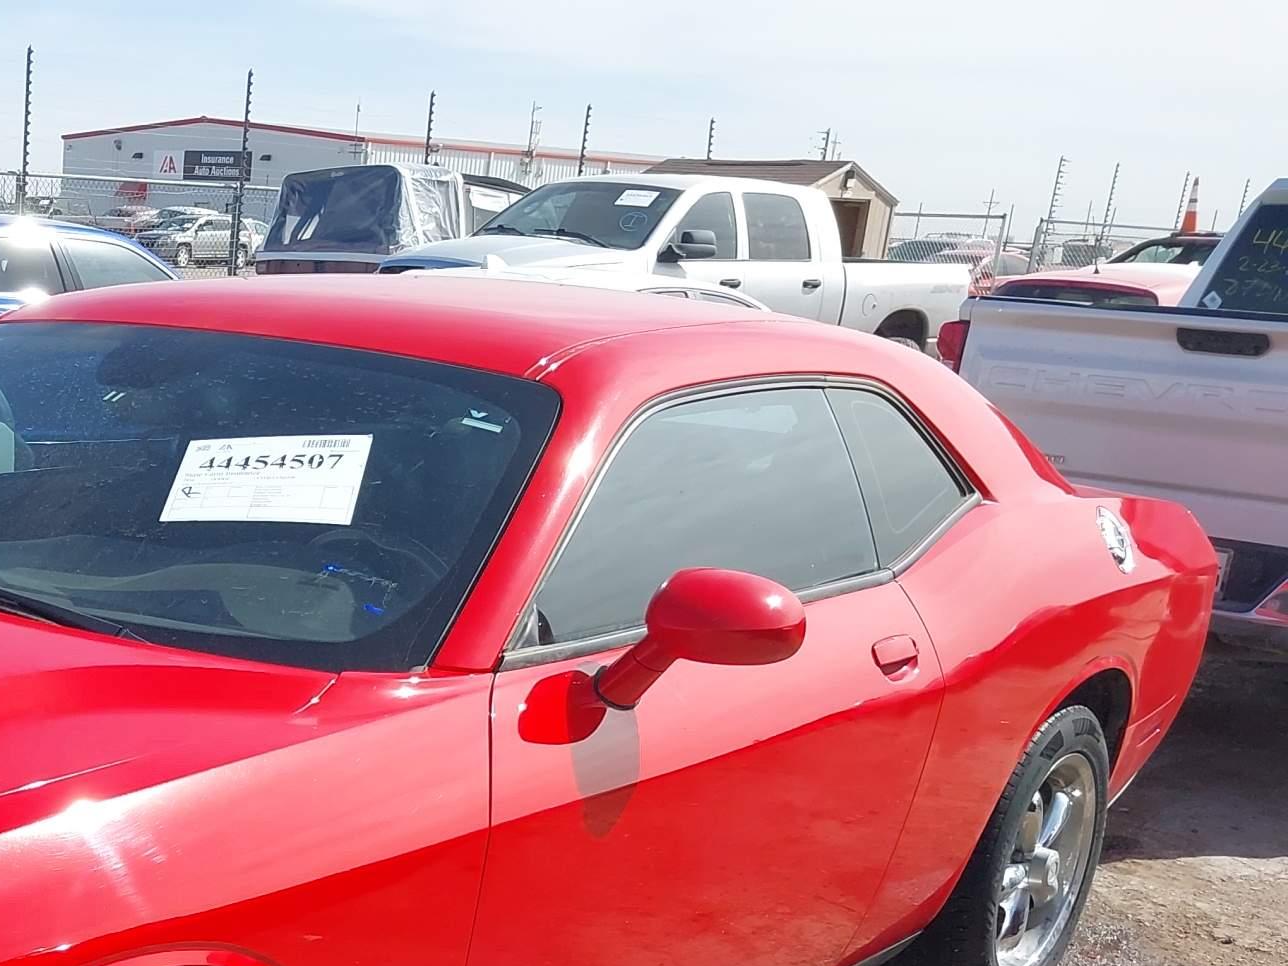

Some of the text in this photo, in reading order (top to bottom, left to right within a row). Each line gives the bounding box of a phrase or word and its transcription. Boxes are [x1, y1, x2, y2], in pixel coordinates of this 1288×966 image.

[201, 154, 234, 164] Insurance
[194, 166, 240, 177] Auto Auctions
[198, 453, 345, 470] 44454507
